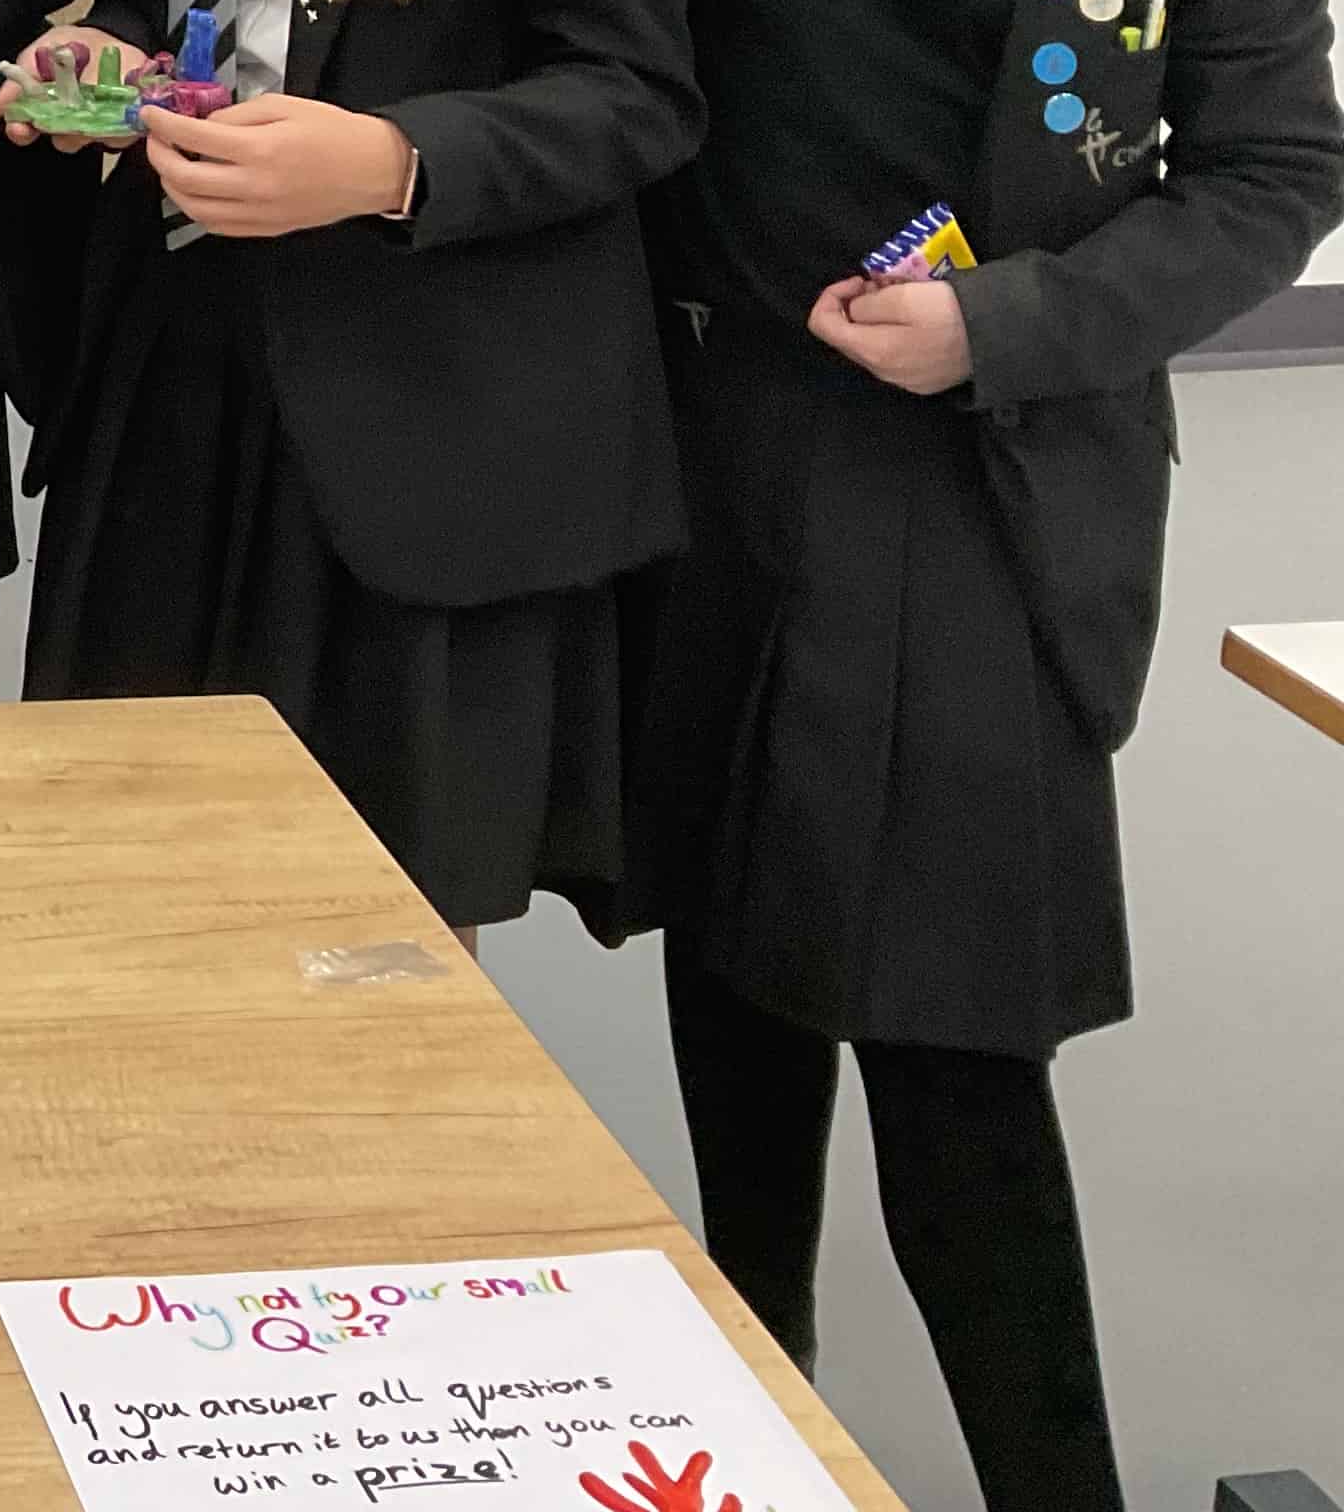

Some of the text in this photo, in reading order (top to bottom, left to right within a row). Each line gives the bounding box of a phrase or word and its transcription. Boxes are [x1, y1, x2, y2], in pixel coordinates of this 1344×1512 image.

[59, 1284, 233, 1351] Why
[235, 1287, 302, 1314] not
[311, 1282, 361, 1321] try
[463, 1268, 573, 1300] small
[252, 1314, 391, 1355] Quiz?
[60, 1375, 615, 1440] If you answer all questions
[88, 1439, 167, 1466] and
[178, 1432, 303, 1459] return
[313, 1432, 342, 1452] it
[357, 1427, 390, 1449] to
[401, 1429, 440, 1447] us
[545, 1419, 616, 1448] you
[630, 1413, 694, 1429] can
[214, 1449, 519, 1502] win a prize!
